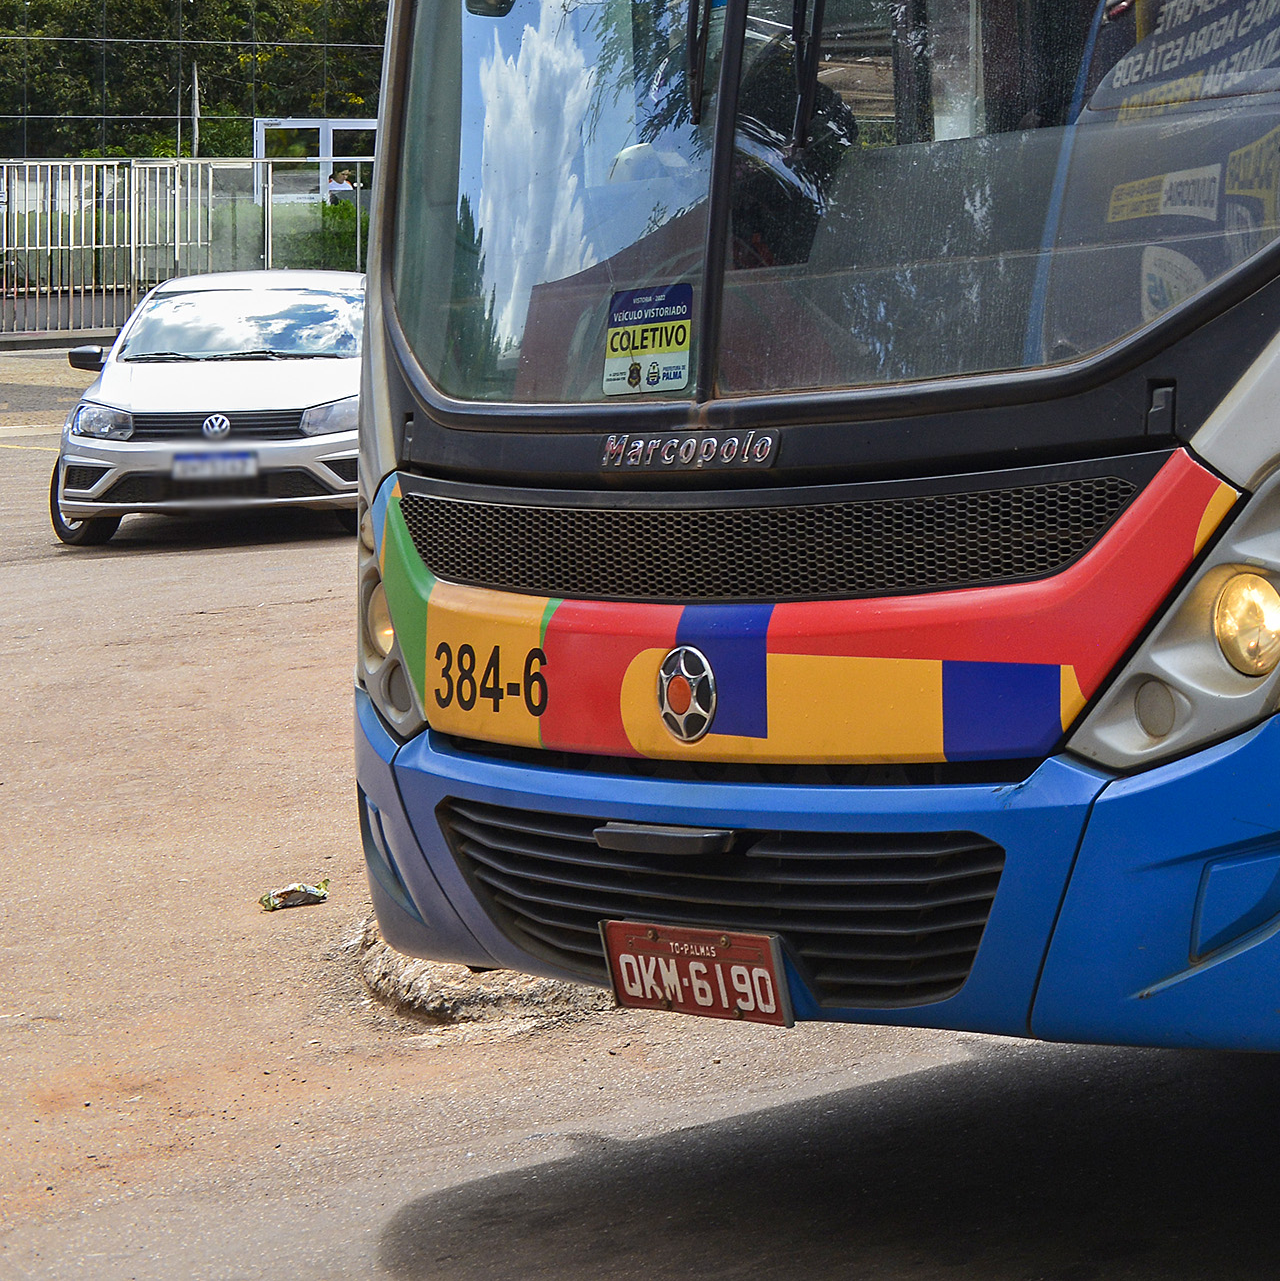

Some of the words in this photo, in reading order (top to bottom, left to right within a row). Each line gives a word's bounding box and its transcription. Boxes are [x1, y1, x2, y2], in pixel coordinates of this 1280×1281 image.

[613, 308, 643, 322] VEÍCULO
[643, 304, 688, 319] VISTORIADO
[609, 324, 687, 353] COLETIVO
[601, 430, 773, 468] Marcopolo
[433, 641, 549, 717] 384-6
